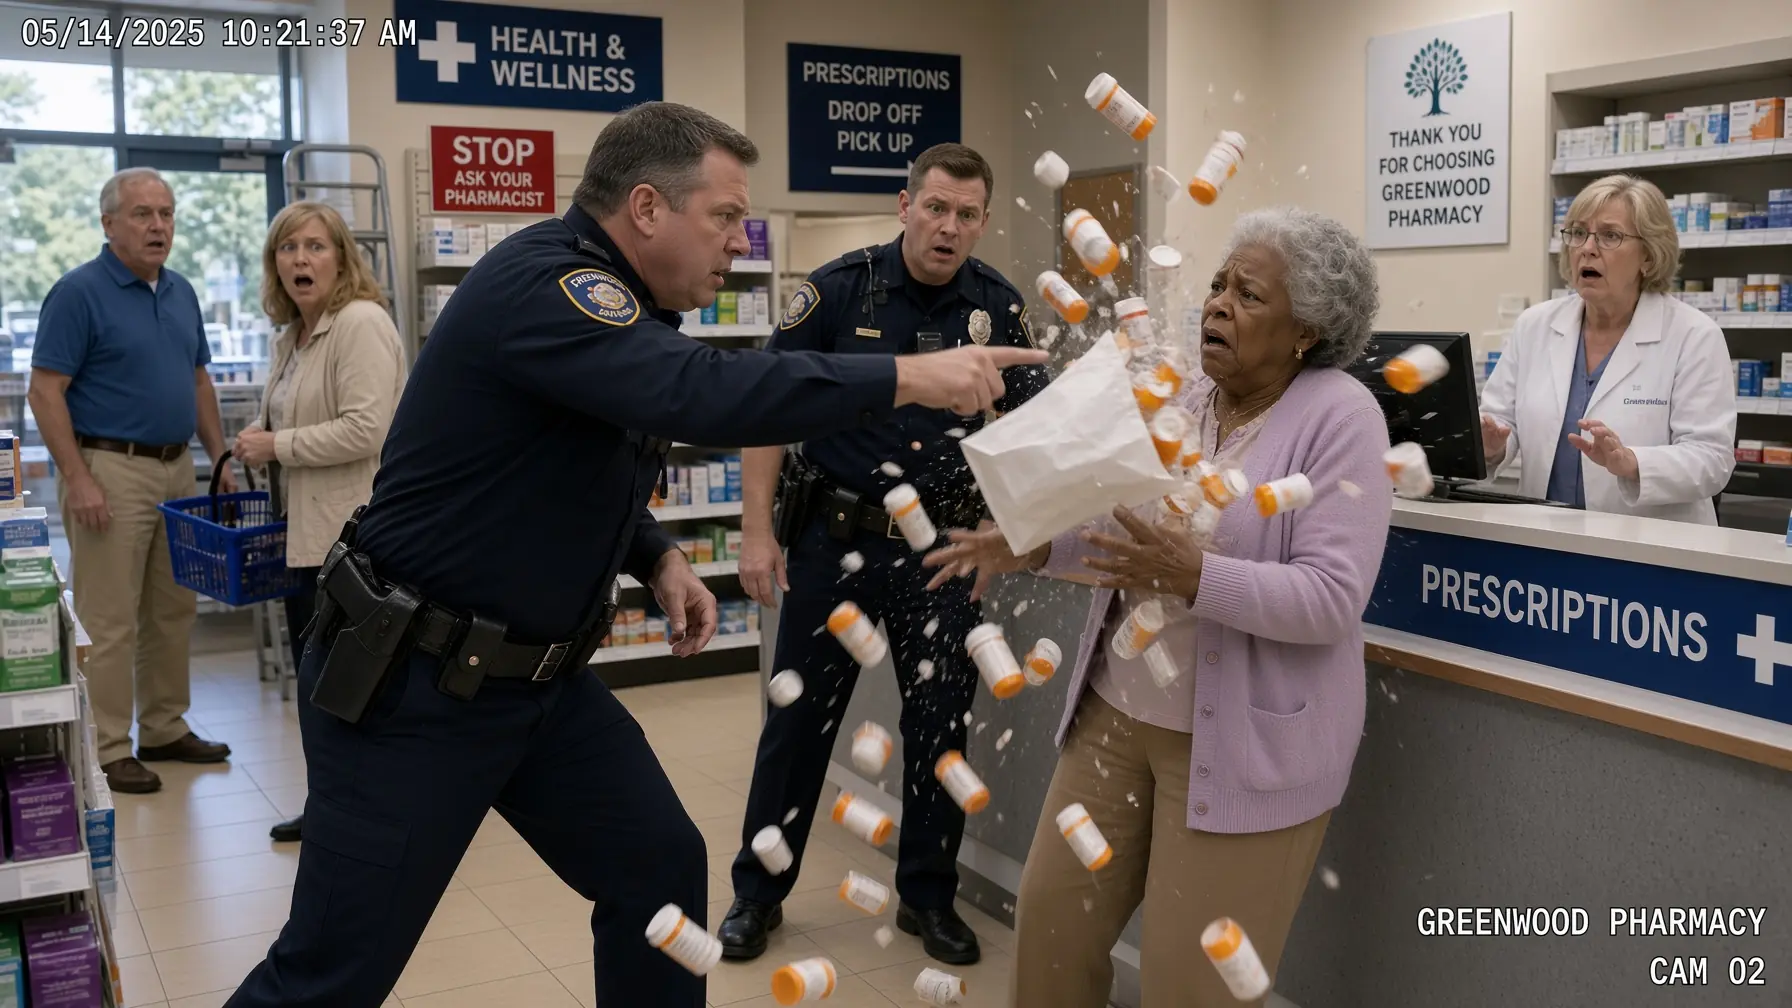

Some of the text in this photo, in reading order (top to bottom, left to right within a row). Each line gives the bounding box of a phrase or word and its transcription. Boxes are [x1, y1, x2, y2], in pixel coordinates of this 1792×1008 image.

[491, 25, 626, 60] HEALTH &
[491, 59, 636, 94] WELLNESS
[803, 61, 950, 91] PRESCRIPTIONS
[828, 100, 923, 124] DROP OFF
[837, 130, 914, 152] PICK UP
[1389, 123, 1482, 148] THANK YOU
[452, 135, 535, 166] STOP
[1379, 148, 1495, 175] FOR CHOOSING
[454, 170, 533, 188] ASK YOUR
[1382, 177, 1491, 202] GREENWOOD
[444, 189, 545, 207] PHARMACIST
[1388, 204, 1484, 228] PHARMACY
[570, 272, 626, 291] GREENWO
[1422, 563, 1708, 662] PRESCRIPTIONS
